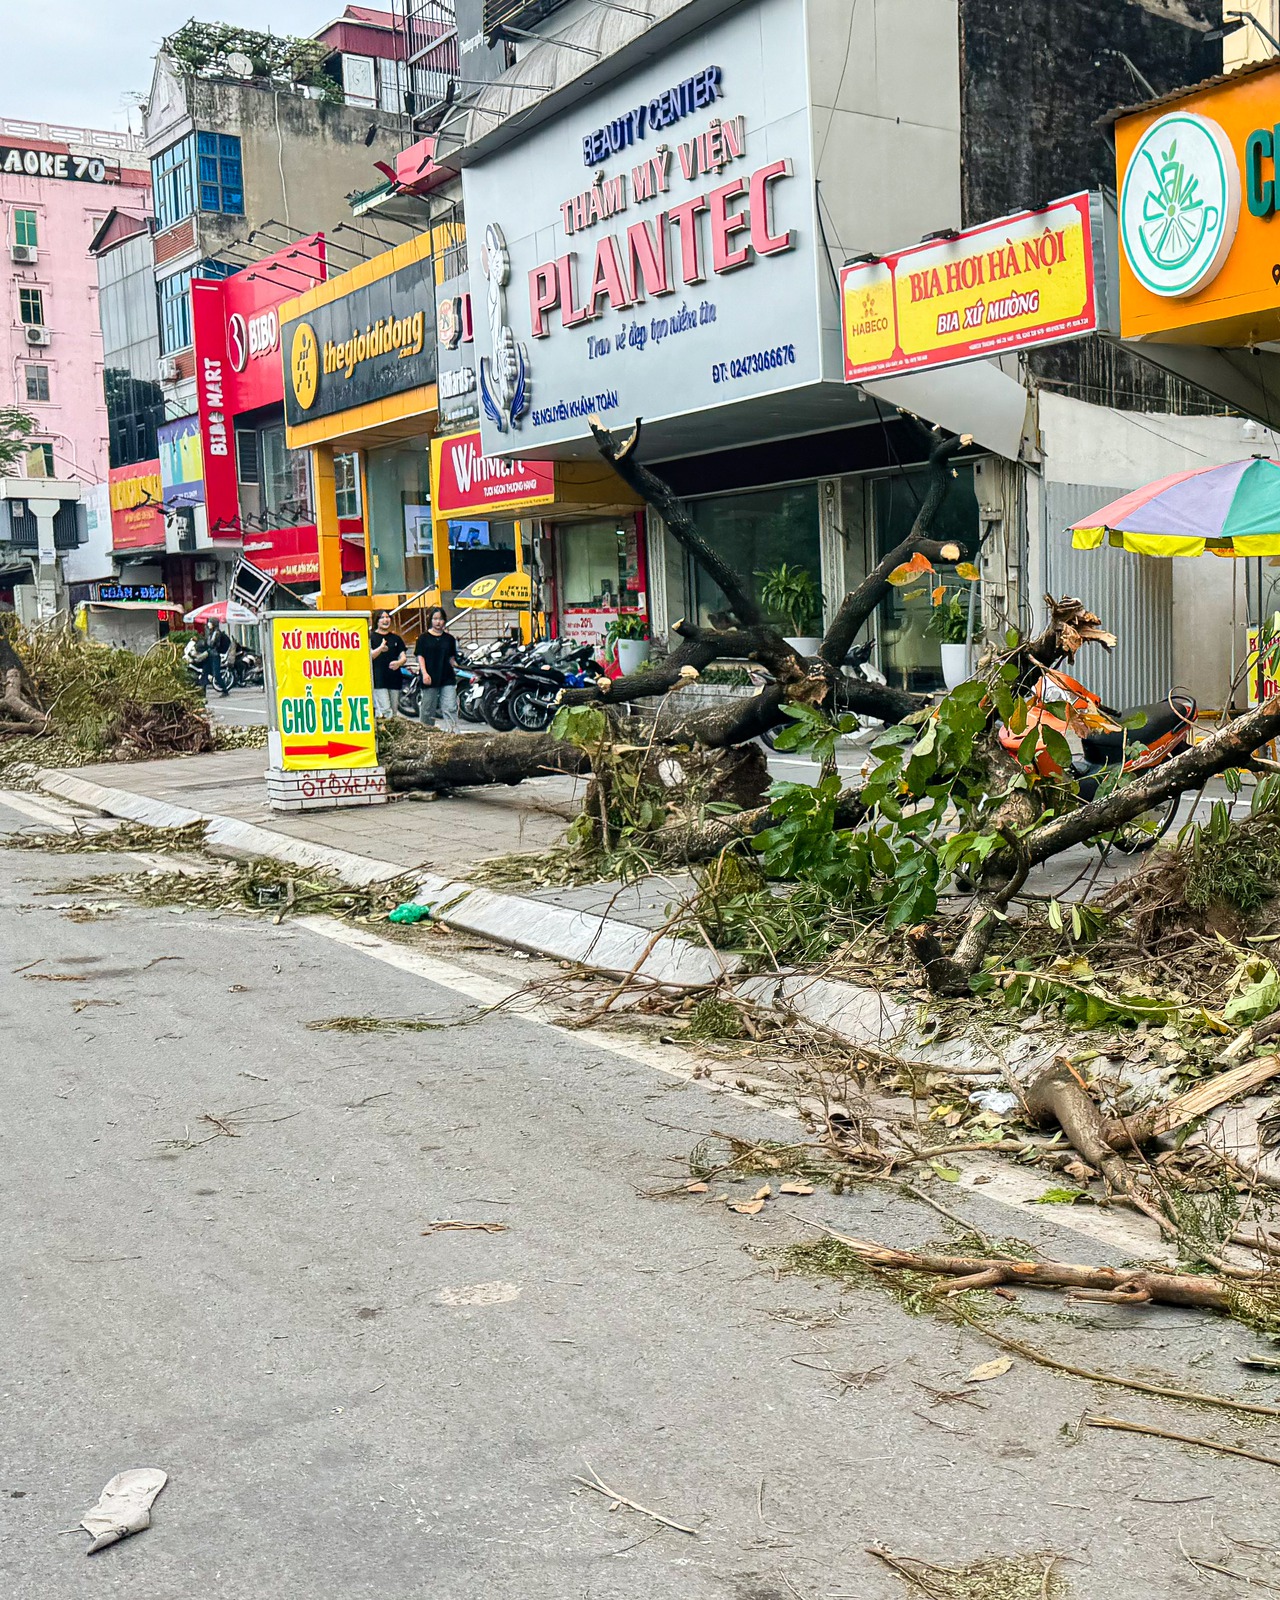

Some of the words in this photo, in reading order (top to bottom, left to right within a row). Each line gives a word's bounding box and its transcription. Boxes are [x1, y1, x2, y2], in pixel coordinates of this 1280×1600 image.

[582, 105, 647, 166] BEAUTY
[648, 64, 723, 131] CENTER
[0, 149, 69, 177] AOKE
[74, 157, 105, 182] 70
[559, 170, 626, 235] THẨM
[631, 144, 673, 204] MỸ
[677, 114, 746, 181] VIỆN
[527, 158, 797, 339] PLANTEC
[909, 264, 944, 303] BIA
[988, 238, 1021, 283] HÀ
[1022, 227, 1067, 275] NỘI
[249, 311, 279, 355] BIBO
[852, 317, 889, 337] HABECO
[937, 313, 959, 336] BIA
[963, 297, 984, 331] XỨ
[986, 290, 1040, 323] MƯỜNG
[323, 311, 425, 379] thegioididong
[712, 363, 729, 384] ĐT:
[730, 344, 796, 380] 02473066676
[203, 357, 225, 407] MART
[596, 389, 619, 411] TOÀN
[207, 411, 228, 456] BIBO
[282, 628, 303, 651] XỨ
[306, 628, 361, 650] MƯỜNG
[302, 655, 344, 677] QUÁN
[281, 684, 318, 735] CHỖ
[320, 683, 345, 733] ĐỂ
[348, 695, 371, 732] XE
